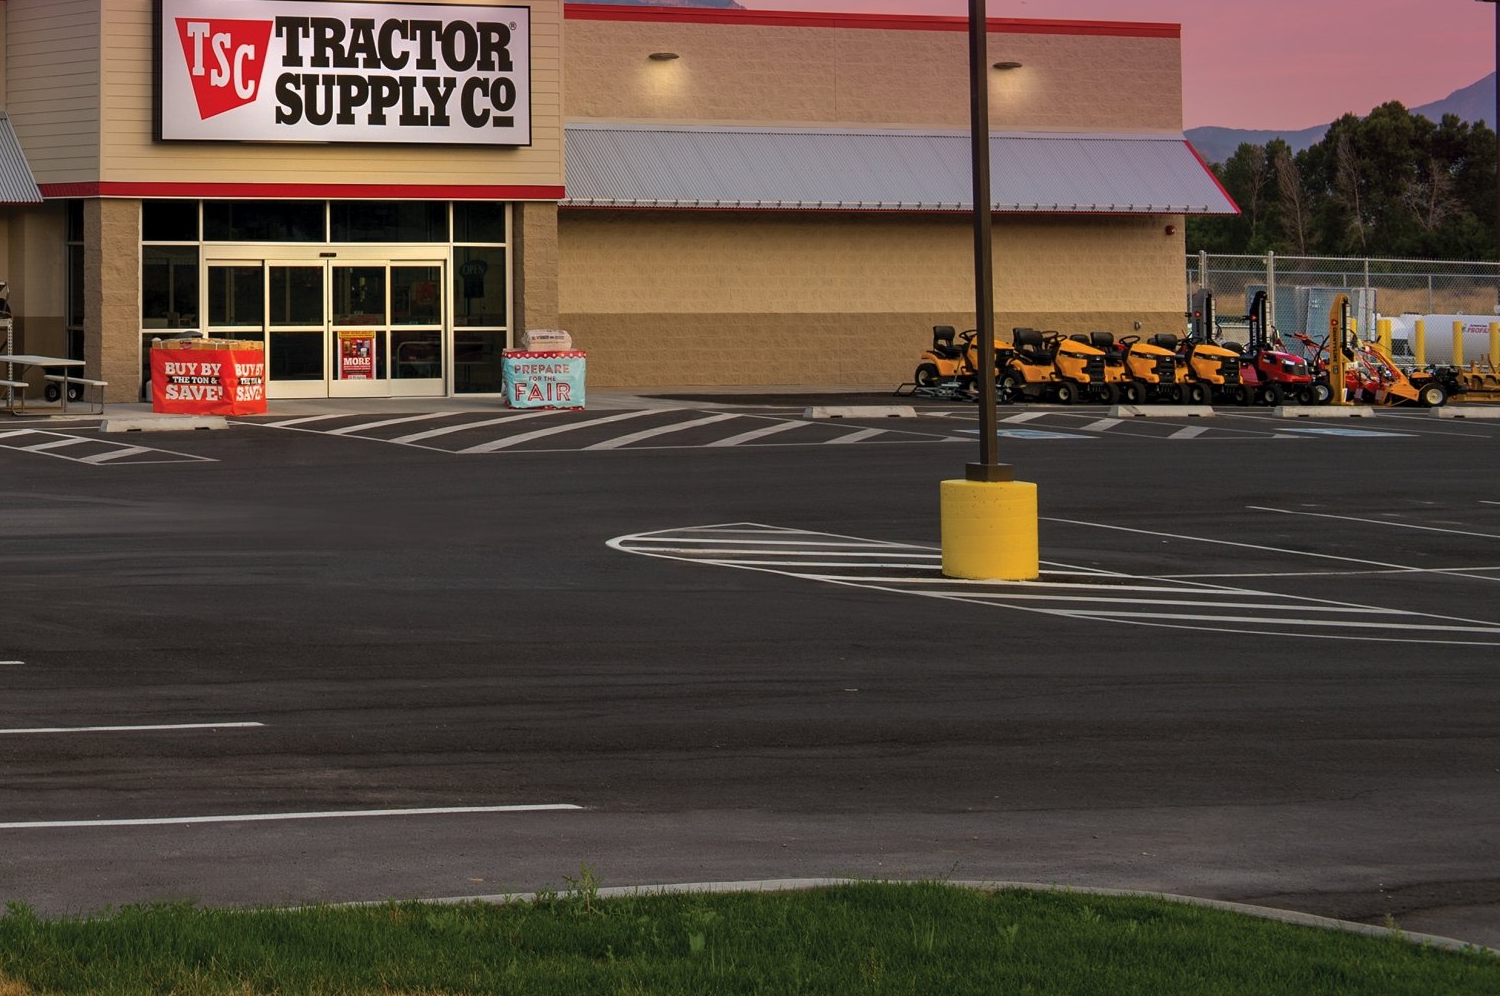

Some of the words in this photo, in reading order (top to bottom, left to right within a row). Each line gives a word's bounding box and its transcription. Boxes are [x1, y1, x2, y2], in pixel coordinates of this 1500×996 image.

[275, 16, 513, 72] TRACTOR
[187, 22, 255, 99] TSC
[275, 73, 457, 126] SUPPLY
[463, 265, 484, 275] OPEN
[343, 357, 371, 365] MORE
[165, 362, 197, 376] BUY
[201, 363, 221, 376] BY
[235, 364, 255, 376] BUY
[514, 364, 570, 374] PREPARE
[165, 384, 223, 401] SAVE!
[514, 383, 571, 402] FAIR
